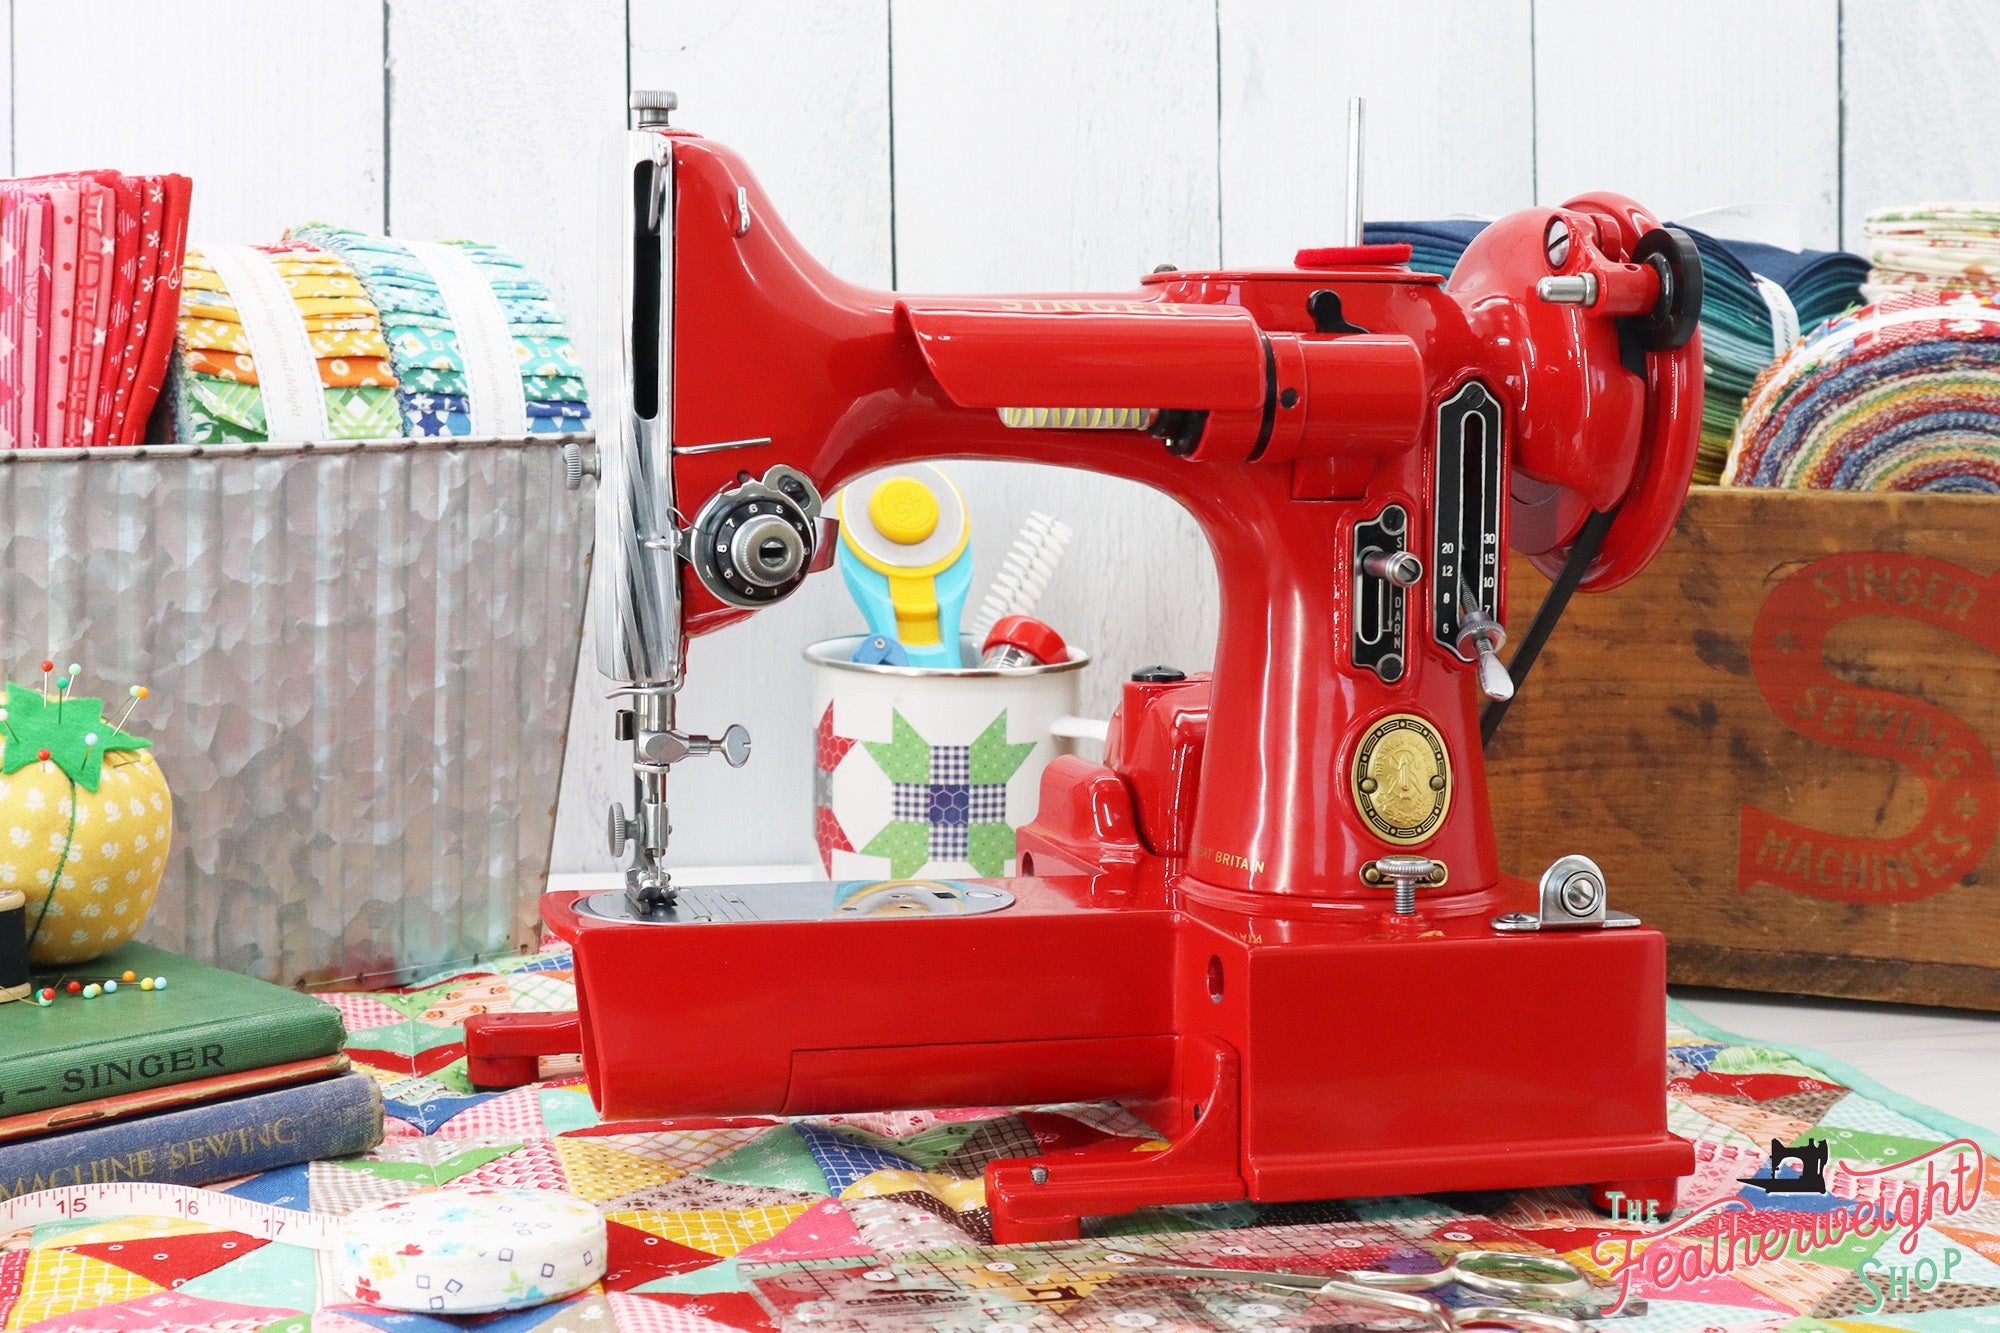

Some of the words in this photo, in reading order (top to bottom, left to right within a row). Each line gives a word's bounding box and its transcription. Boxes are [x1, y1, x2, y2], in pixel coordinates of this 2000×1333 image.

[277, 348, 294, 372] and
[283, 373, 303, 418] delight
[748, 504, 758, 513] 6
[775, 505, 784, 513] 5
[1441, 543, 1454, 554] 20
[1484, 533, 1496, 544] 30
[1442, 566, 1453, 577] 12
[1484, 554, 1495, 565] 15
[1483, 576, 1495, 588] 10
[1811, 563, 1979, 620] SINGER
[1443, 593, 1450, 604] 8
[1394, 597, 1403, 649] DARN
[1443, 623, 1450, 634] 6
[1792, 684, 1973, 781] SEWING
[1756, 825, 1972, 891] MACHINES
[62, 1043, 225, 1094] SINGER
[0, 1148, 155, 1202] MACHINE
[169, 1117, 297, 1170] SEWING
[56, 1197, 87, 1215] 15
[175, 1199, 199, 1215] 16
[263, 1219, 285, 1236] 17
